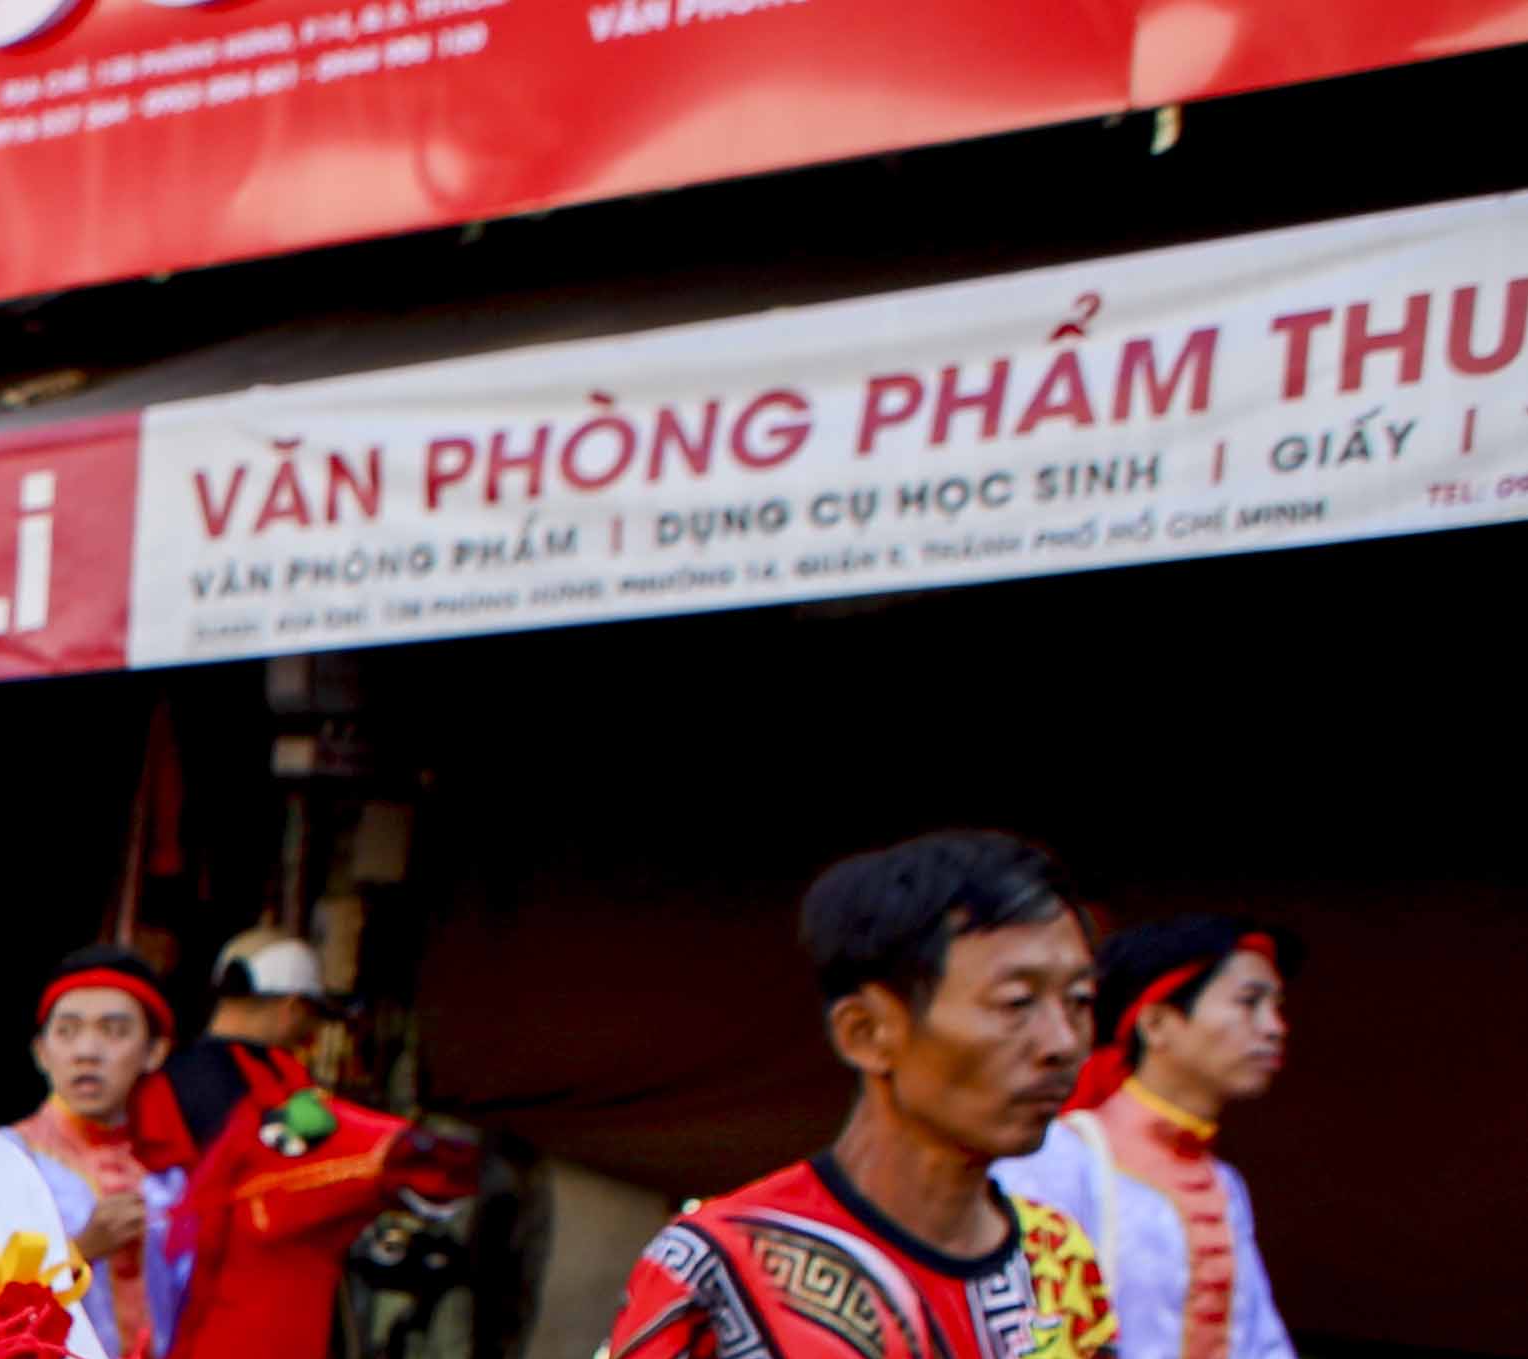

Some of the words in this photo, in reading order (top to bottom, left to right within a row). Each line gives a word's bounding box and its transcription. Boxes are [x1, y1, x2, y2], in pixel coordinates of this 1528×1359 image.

[192, 435, 384, 540] VĂN
[425, 388, 816, 511] PHÒNG
[854, 292, 1218, 458] PHẨM
[656, 501, 790, 550] DỤNG
[810, 485, 880, 530] CỤ
[898, 470, 1016, 522] HỌC
[1033, 454, 1164, 504] SINH
[1268, 404, 1418, 474] GIẤY
